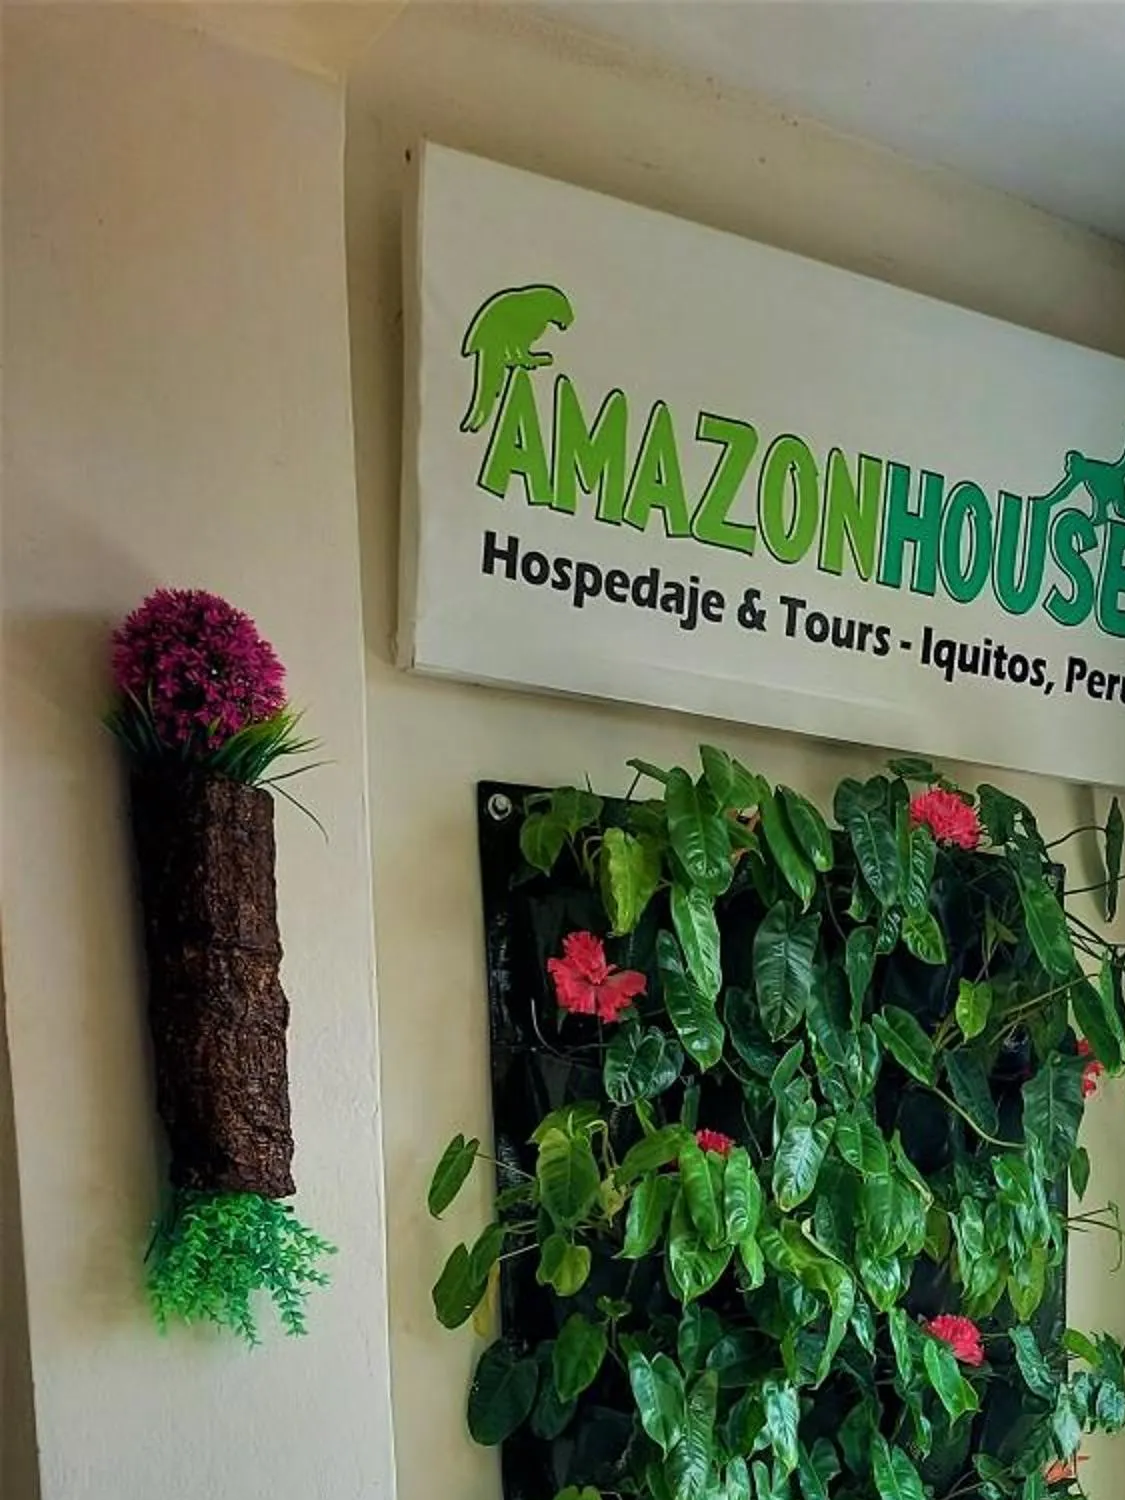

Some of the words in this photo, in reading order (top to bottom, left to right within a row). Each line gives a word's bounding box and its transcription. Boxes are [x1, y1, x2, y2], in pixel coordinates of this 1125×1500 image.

[481, 530, 725, 631] Hospedaje
[736, 587, 768, 632] &
[779, 595, 891, 657] Tours
[899, 640, 912, 651] -
[920, 626, 1055, 695] Iquitos,
